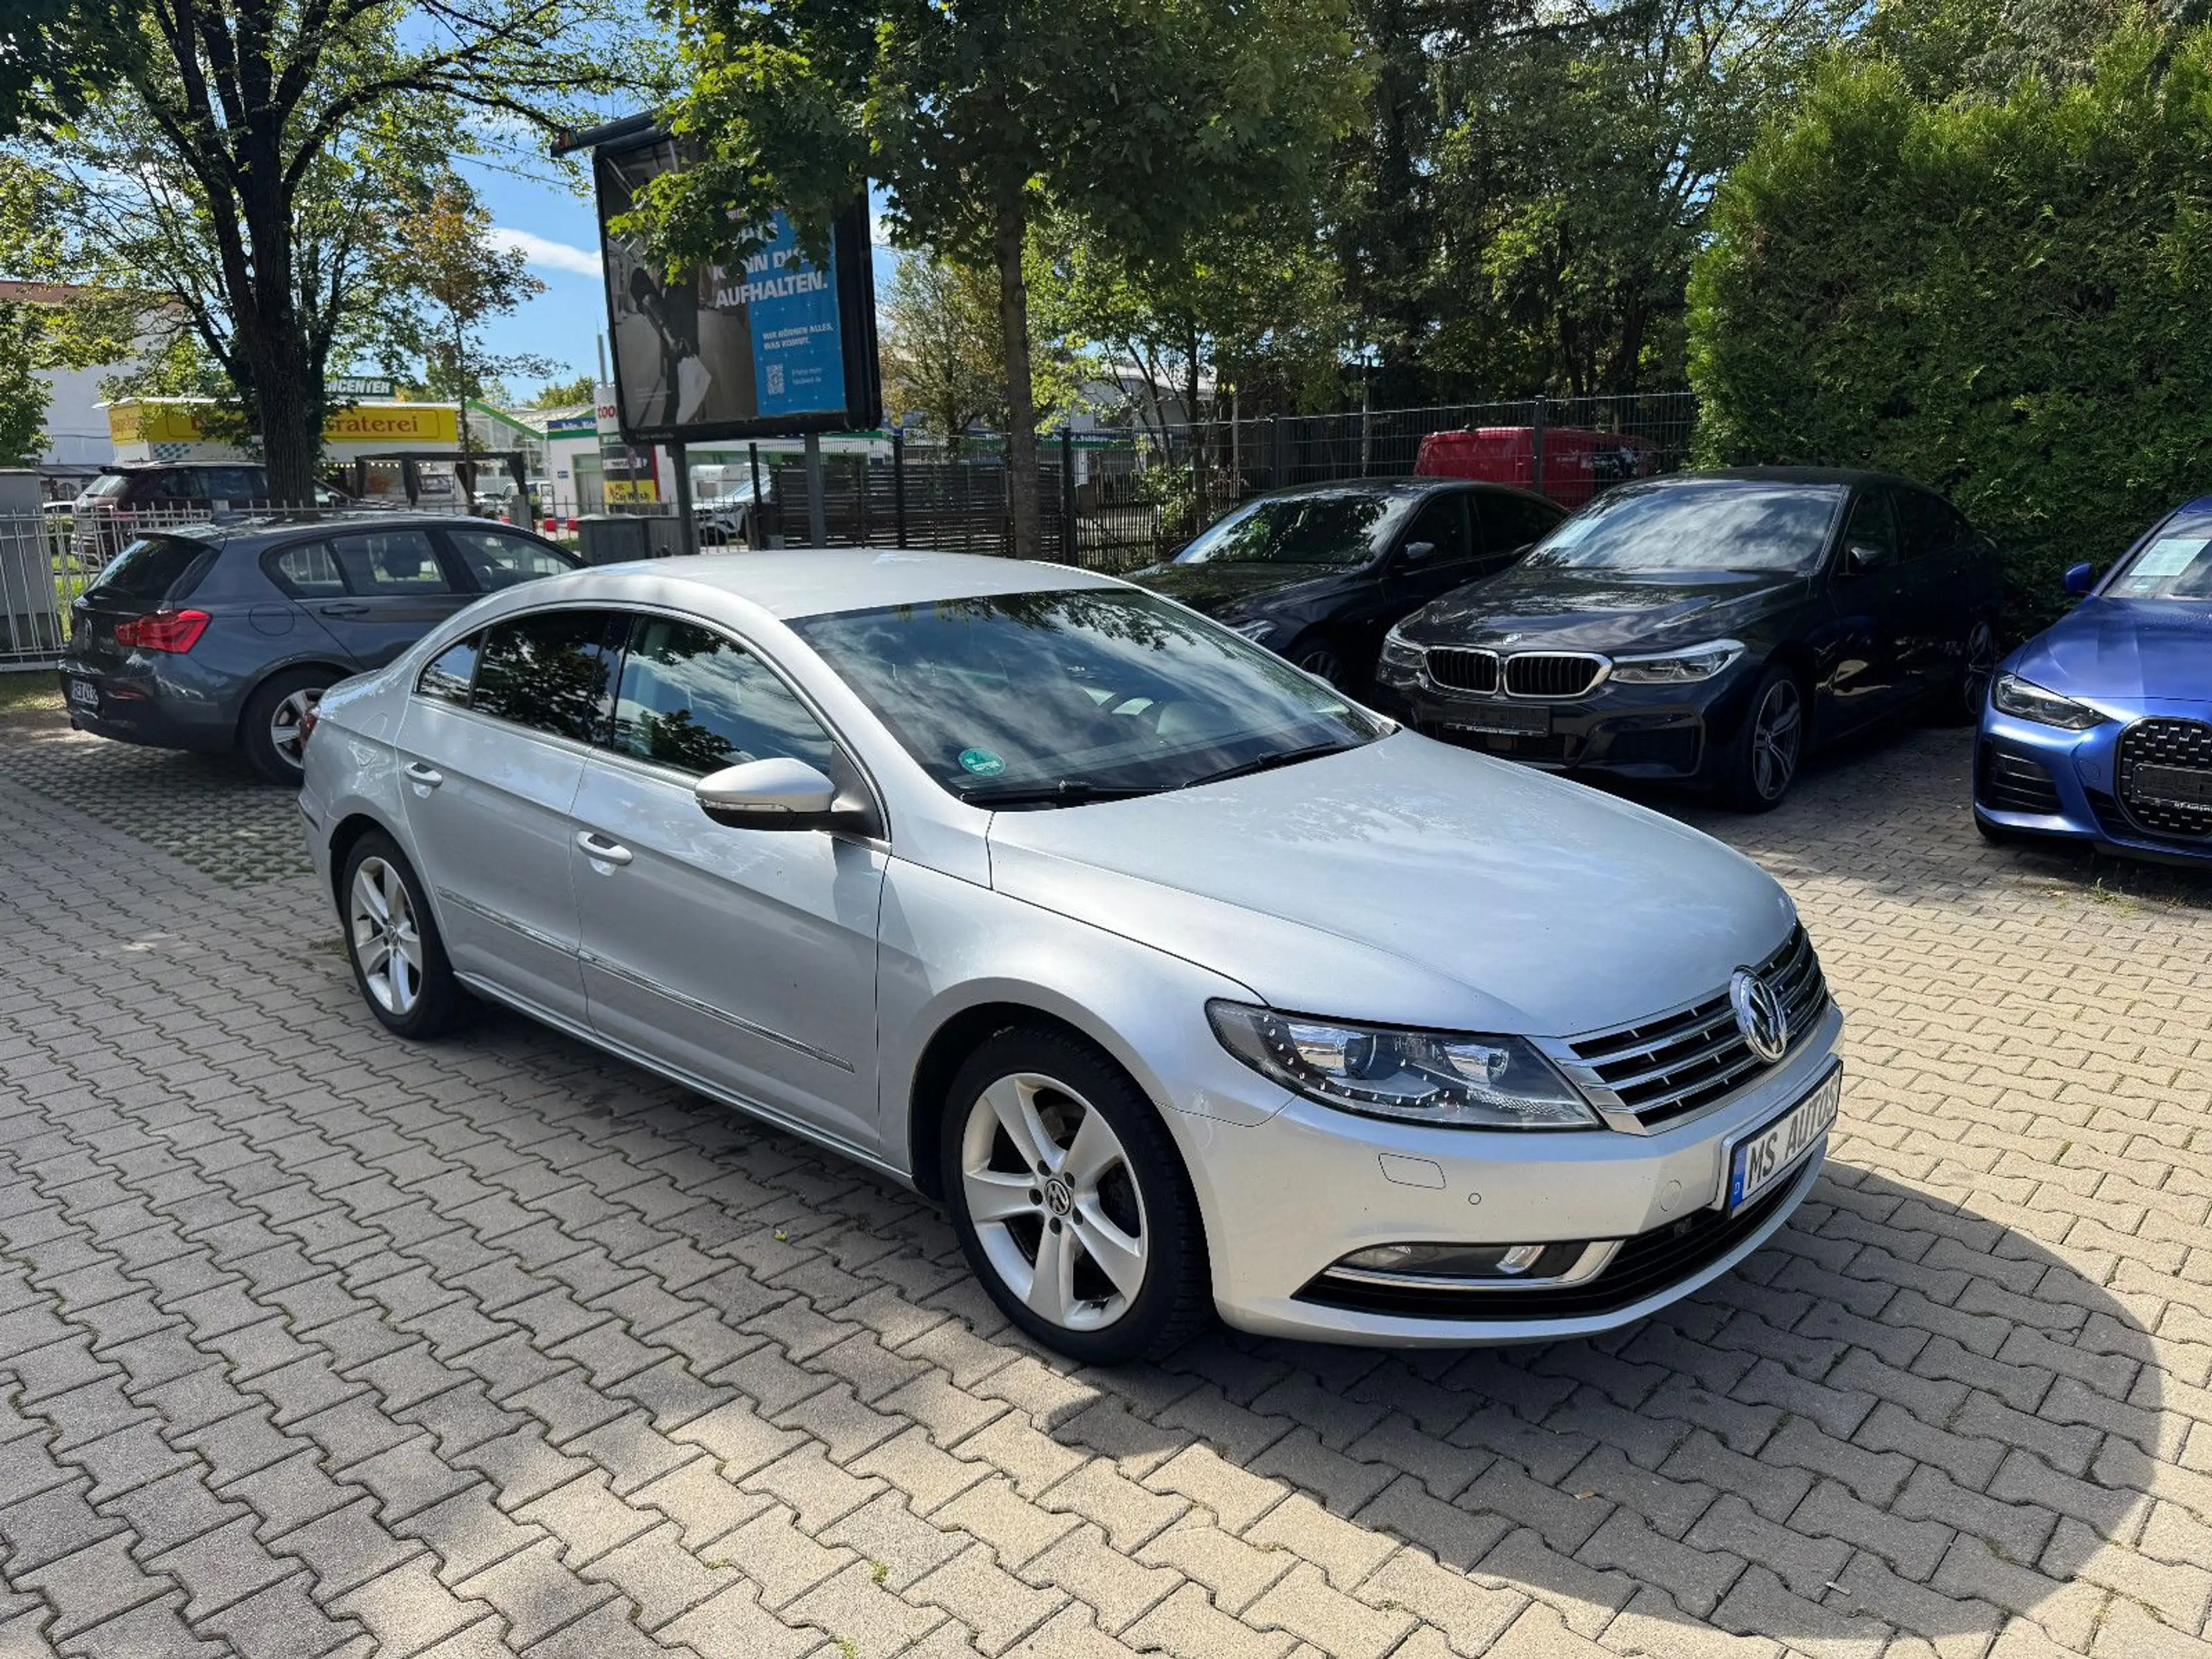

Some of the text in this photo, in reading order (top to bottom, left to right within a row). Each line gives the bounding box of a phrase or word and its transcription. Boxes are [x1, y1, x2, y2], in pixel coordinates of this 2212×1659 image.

[713, 253, 768, 281] KNN
[714, 271, 828, 309] AUFHALTEN.
[329, 415, 419, 432] raterei
[597, 406, 619, 419] too
[1748, 1076, 1838, 1190] MS AUTOS
